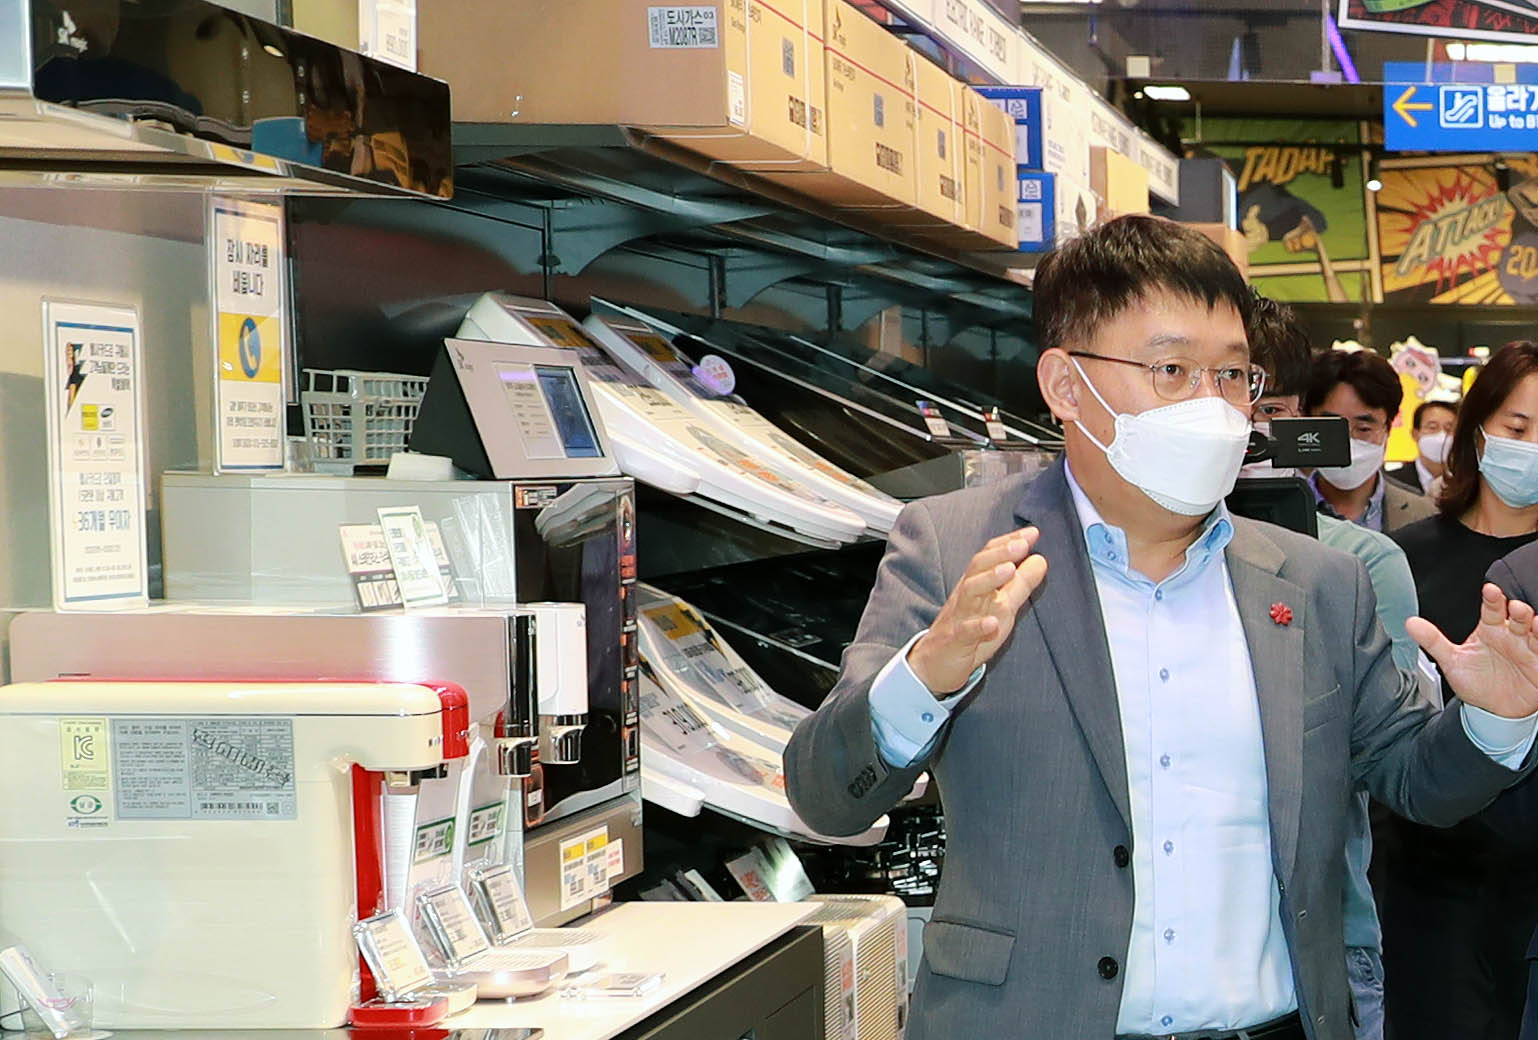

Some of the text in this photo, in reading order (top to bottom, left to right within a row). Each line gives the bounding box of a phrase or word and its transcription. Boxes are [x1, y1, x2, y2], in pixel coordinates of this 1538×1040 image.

[1488, 115, 1506, 129] Up
[1508, 115, 1525, 129] to
[1297, 432, 1320, 444] 4K
